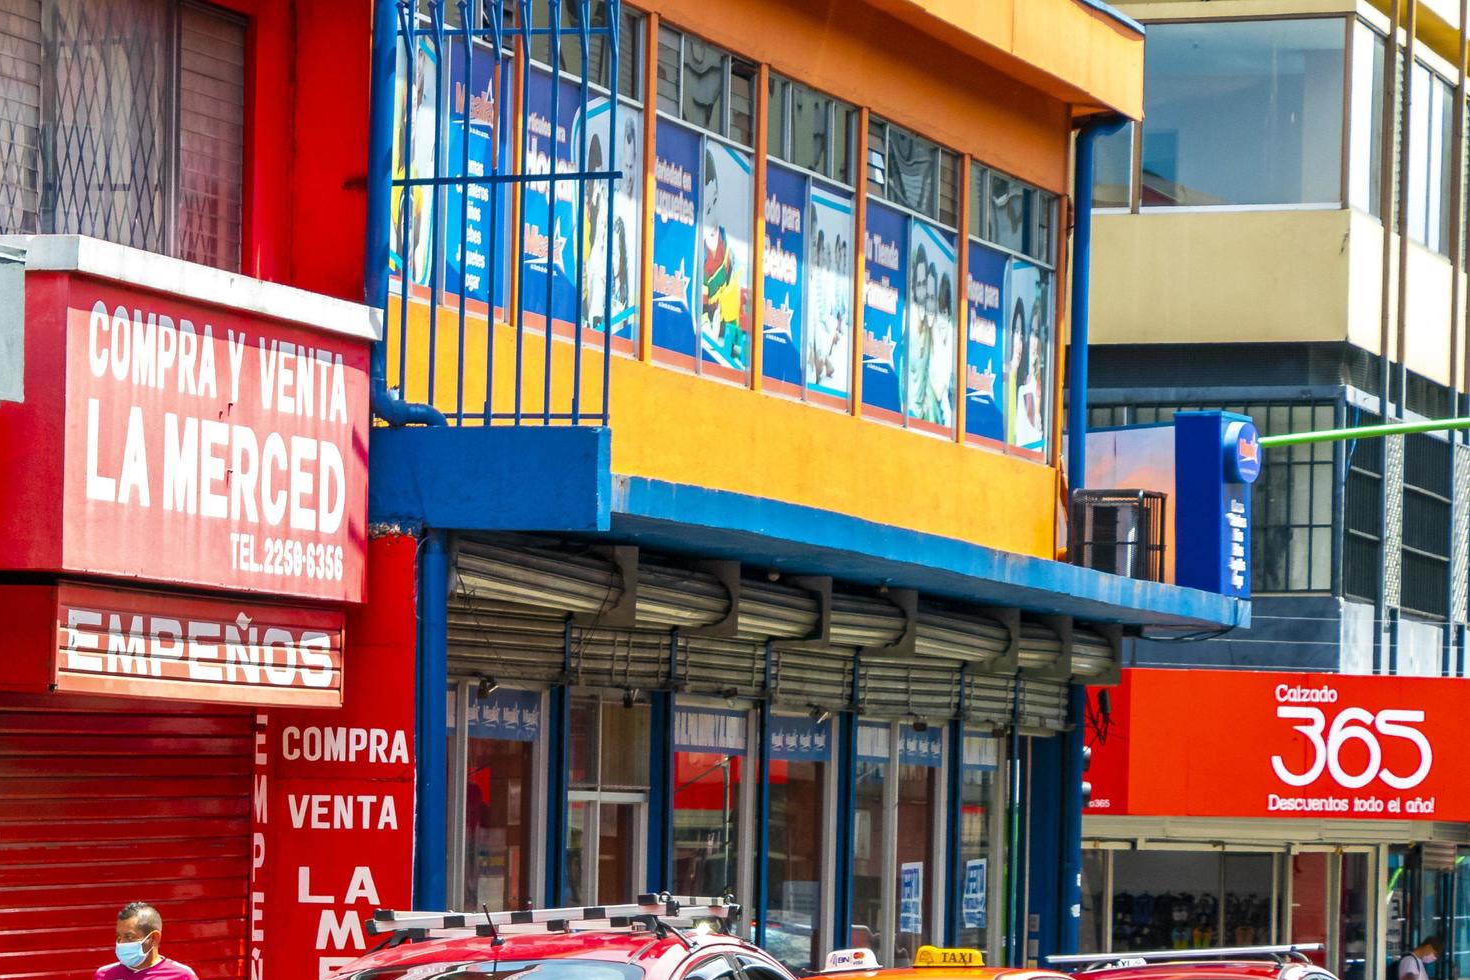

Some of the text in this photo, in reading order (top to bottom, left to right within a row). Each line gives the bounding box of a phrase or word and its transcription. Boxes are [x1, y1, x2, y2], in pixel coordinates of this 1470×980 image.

[655, 189, 695, 227] uguetes
[89, 300, 348, 425] COMPRA Y VENTA
[85, 398, 346, 535] LA MERCED
[67, 608, 334, 688] EMPEÑOS
[1275, 684, 1338, 702] Calzado
[282, 726, 409, 763] COMPRA
[1271, 706, 1433, 789] 365
[288, 795, 398, 830] VENTA
[1267, 794, 1435, 813] Descuentos todo el año!
[298, 866, 380, 905] LA
[942, 952, 972, 963] TAXI
